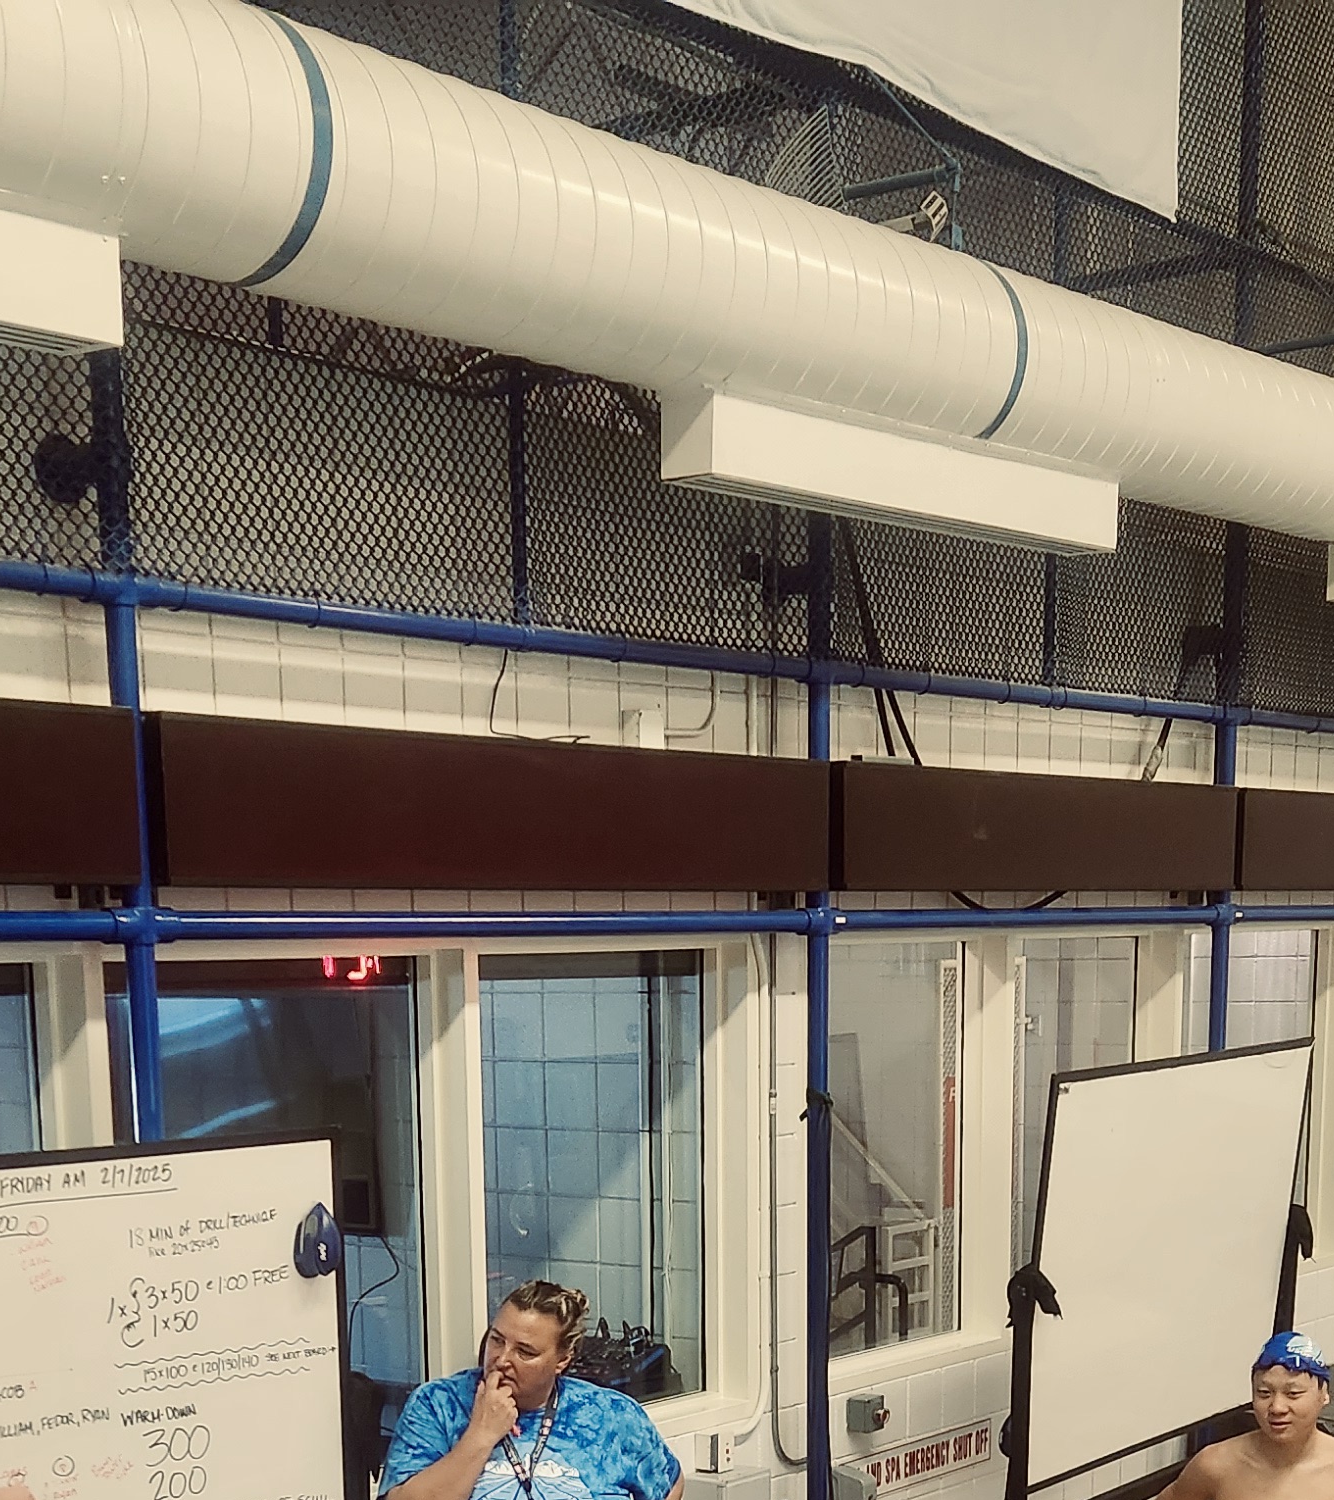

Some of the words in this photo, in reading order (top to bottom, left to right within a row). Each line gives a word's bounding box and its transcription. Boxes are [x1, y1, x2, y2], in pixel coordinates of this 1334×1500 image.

[62, 1170, 85, 1188] AM
[149, 1228, 173, 1242] MIN
[253, 1265, 290, 1286] FREE
[142, 1425, 210, 1467] 300
[867, 1463, 882, 1487] ND
[885, 1459, 901, 1485] SPA
[904, 1440, 950, 1478] EMERGENCY
[952, 1435, 972, 1461] SHUT
[975, 1427, 988, 1453] OFF
